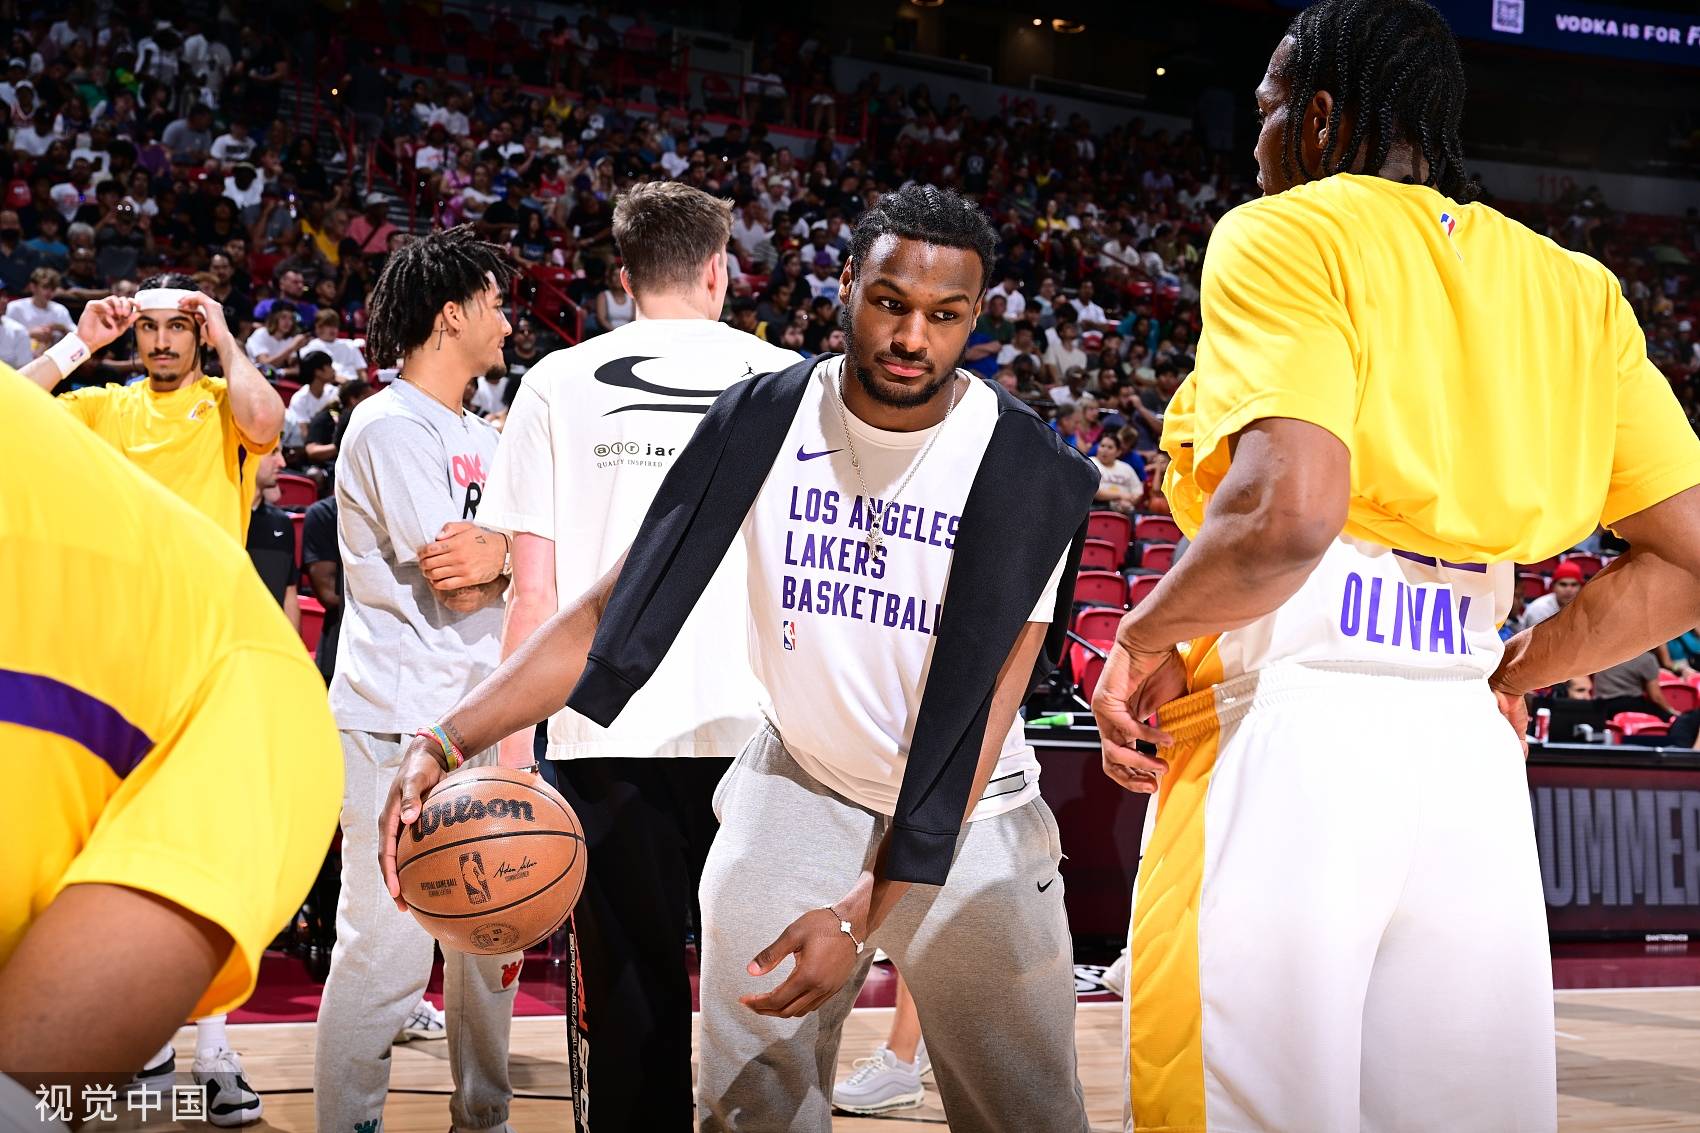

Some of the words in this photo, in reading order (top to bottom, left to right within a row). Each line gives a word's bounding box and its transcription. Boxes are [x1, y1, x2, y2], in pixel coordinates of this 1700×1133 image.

[1555, 14, 1618, 36] VODKA
[1622, 23, 1639, 39] IS
[1643, 25, 1681, 44] FOR
[789, 486, 840, 524] LOS
[848, 495, 961, 550] ANGELES
[784, 531, 888, 579] LAKERS
[410, 795, 535, 842] Wilson
